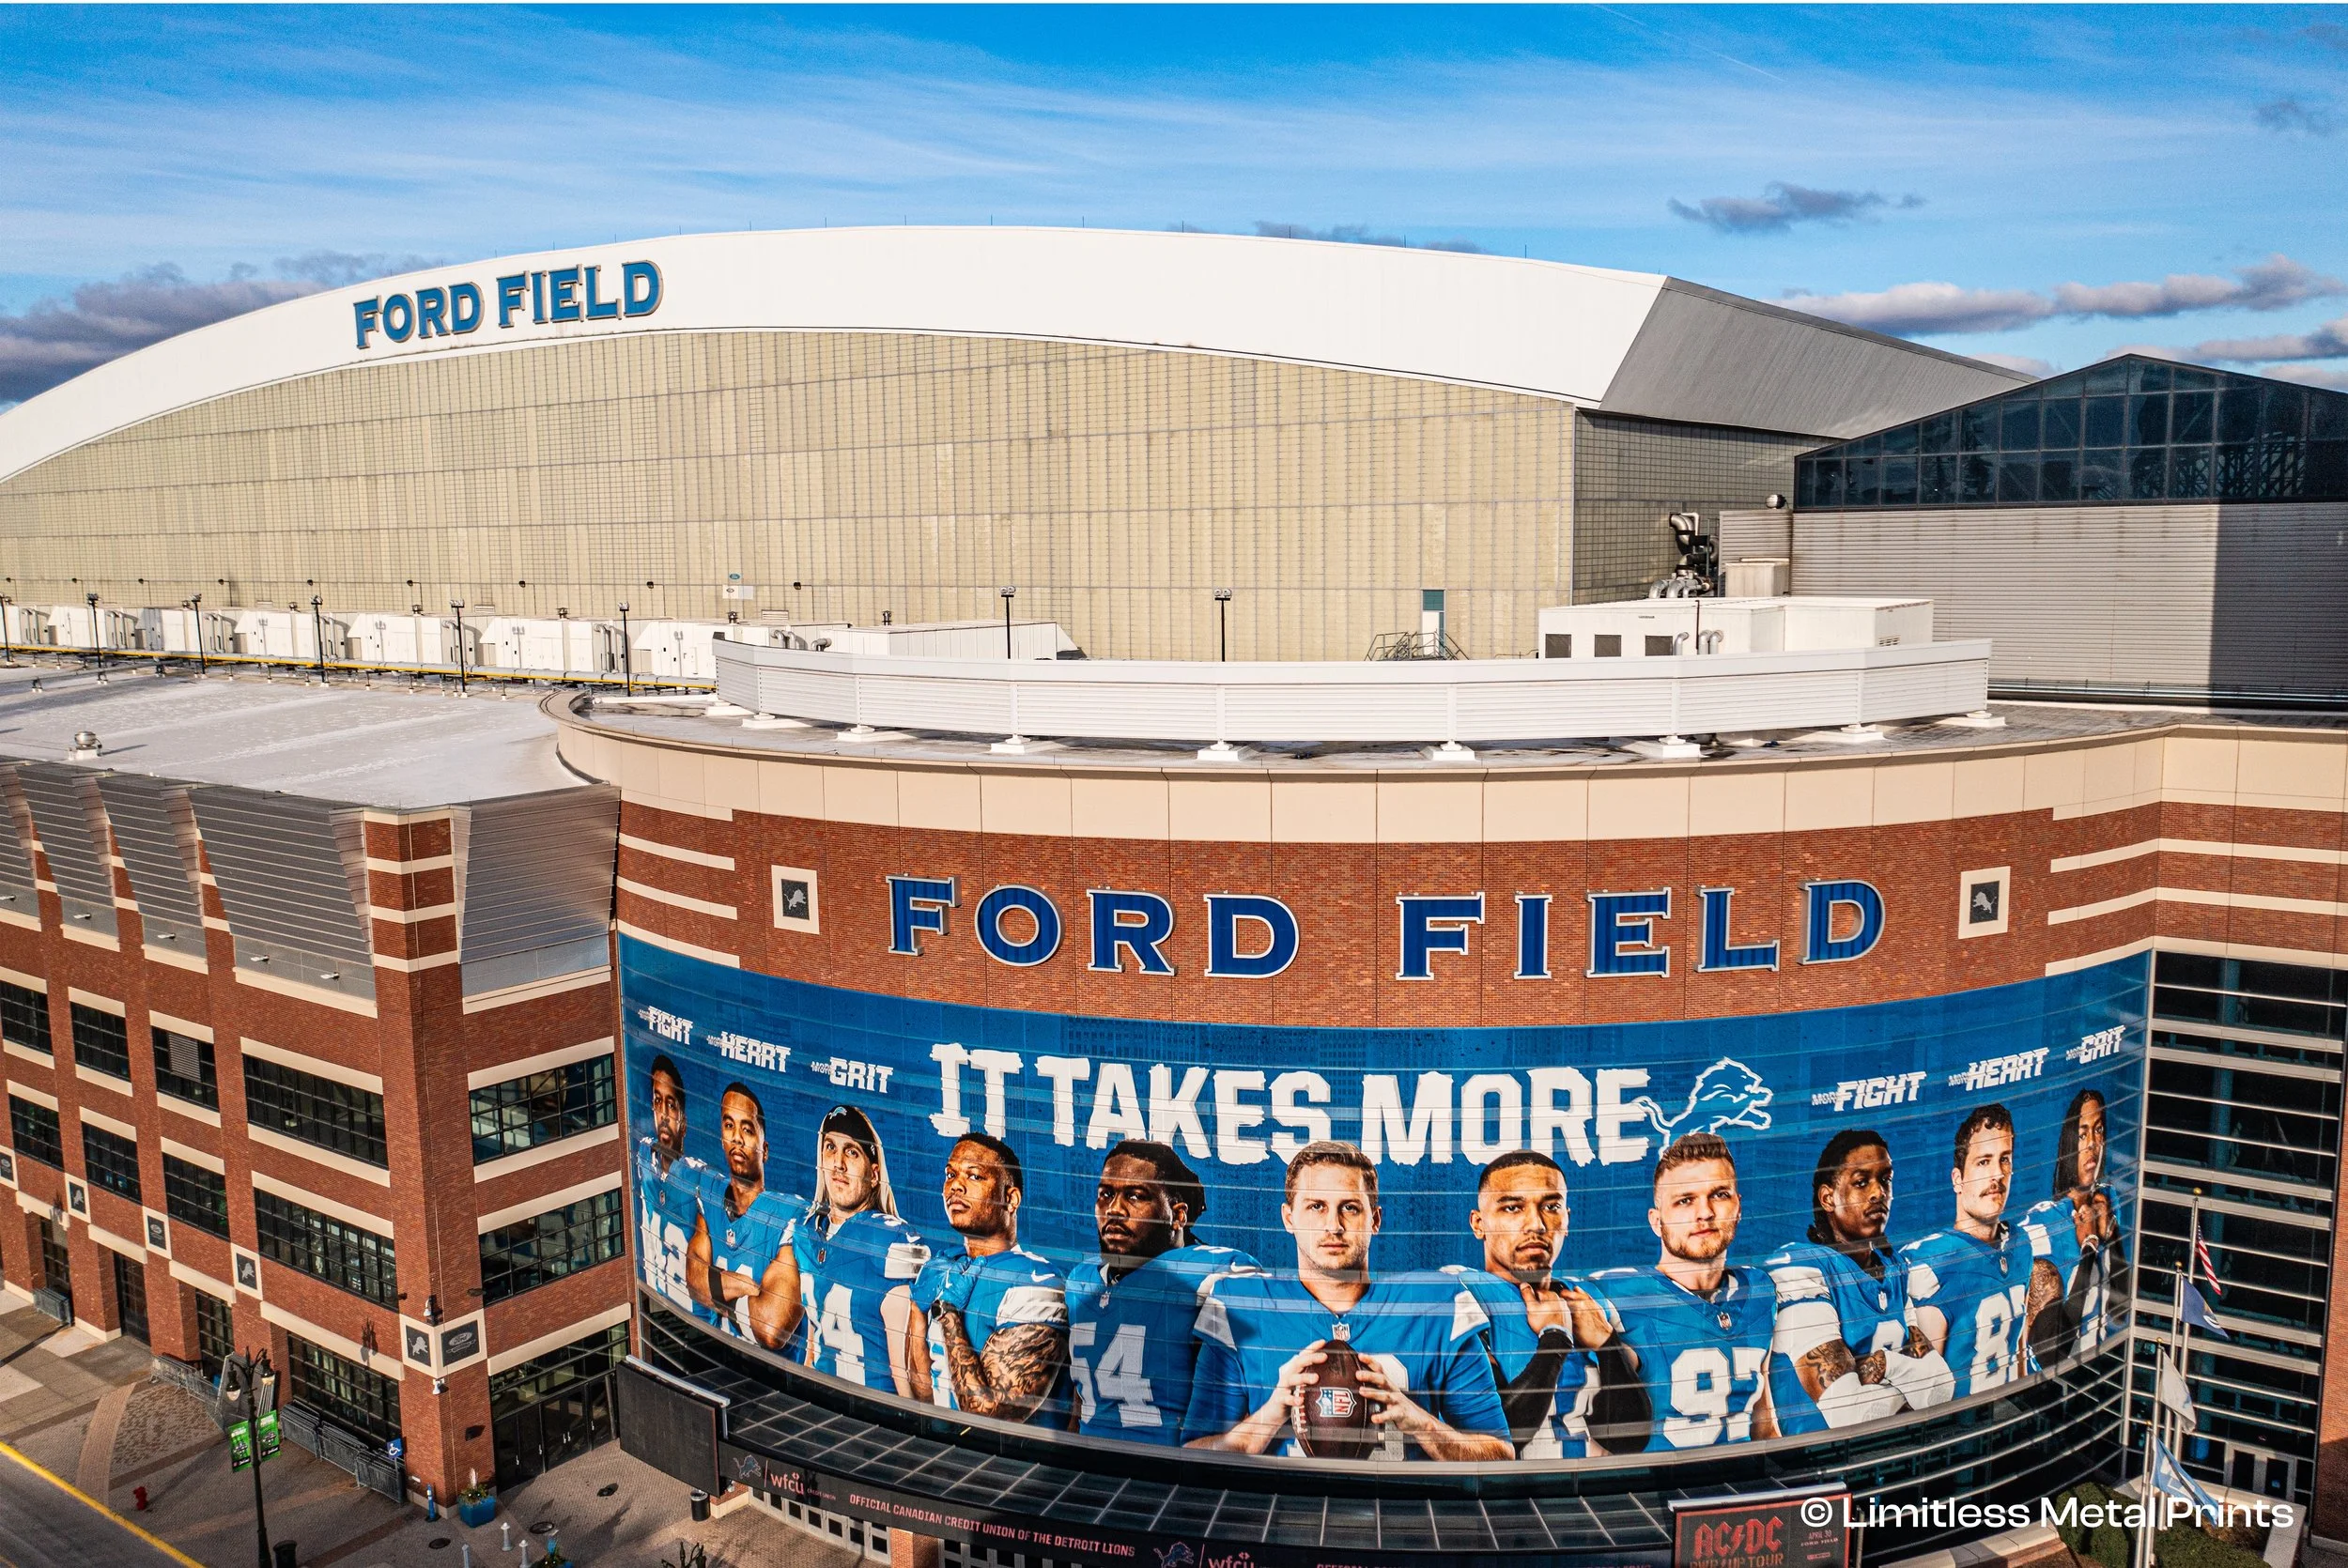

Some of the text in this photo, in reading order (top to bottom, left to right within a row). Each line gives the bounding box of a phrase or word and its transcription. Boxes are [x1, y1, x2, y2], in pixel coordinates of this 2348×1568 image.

[353, 259, 663, 349] FORD FIELD
[886, 874, 1886, 980] FORD FIELD
[648, 1006, 693, 1045] FIGHT
[720, 1031, 791, 1072] HEART
[1966, 1047, 2049, 1091] HEART
[829, 1056, 893, 1093] GRIT
[1834, 1071, 1927, 1112] FIGHT
[929, 1042, 1651, 1166] IT TAKES MORE
[1069, 1322, 1162, 1427] 54
[1335, 1392, 1352, 1414] NFL
[1663, 1347, 1768, 1448] 97
[770, 1473, 804, 1495] wfcu
[850, 1494, 1135, 1557] OFFICIAL CANADIAN CREDIT UNION OF THE DETROIT LIONS
